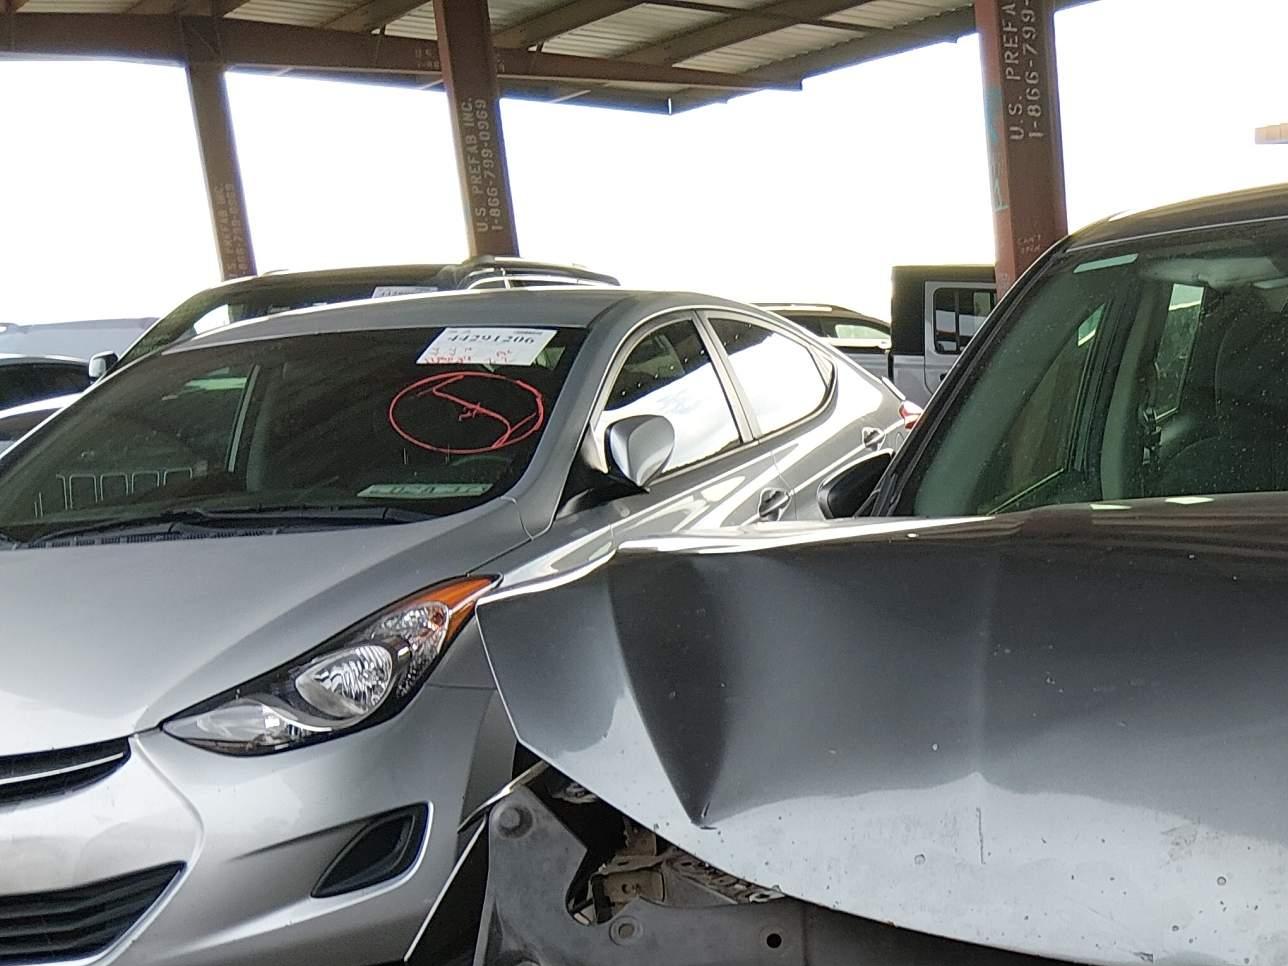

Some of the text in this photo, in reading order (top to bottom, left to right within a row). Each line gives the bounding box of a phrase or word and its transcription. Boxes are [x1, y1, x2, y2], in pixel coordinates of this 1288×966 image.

[461, 97, 475, 128] INC.
[1008, 96, 1025, 140] U.S.
[465, 134, 484, 195] PREFAB
[475, 99, 503, 231] 1-866-799-0969
[448, 334, 536, 345] 44291206
